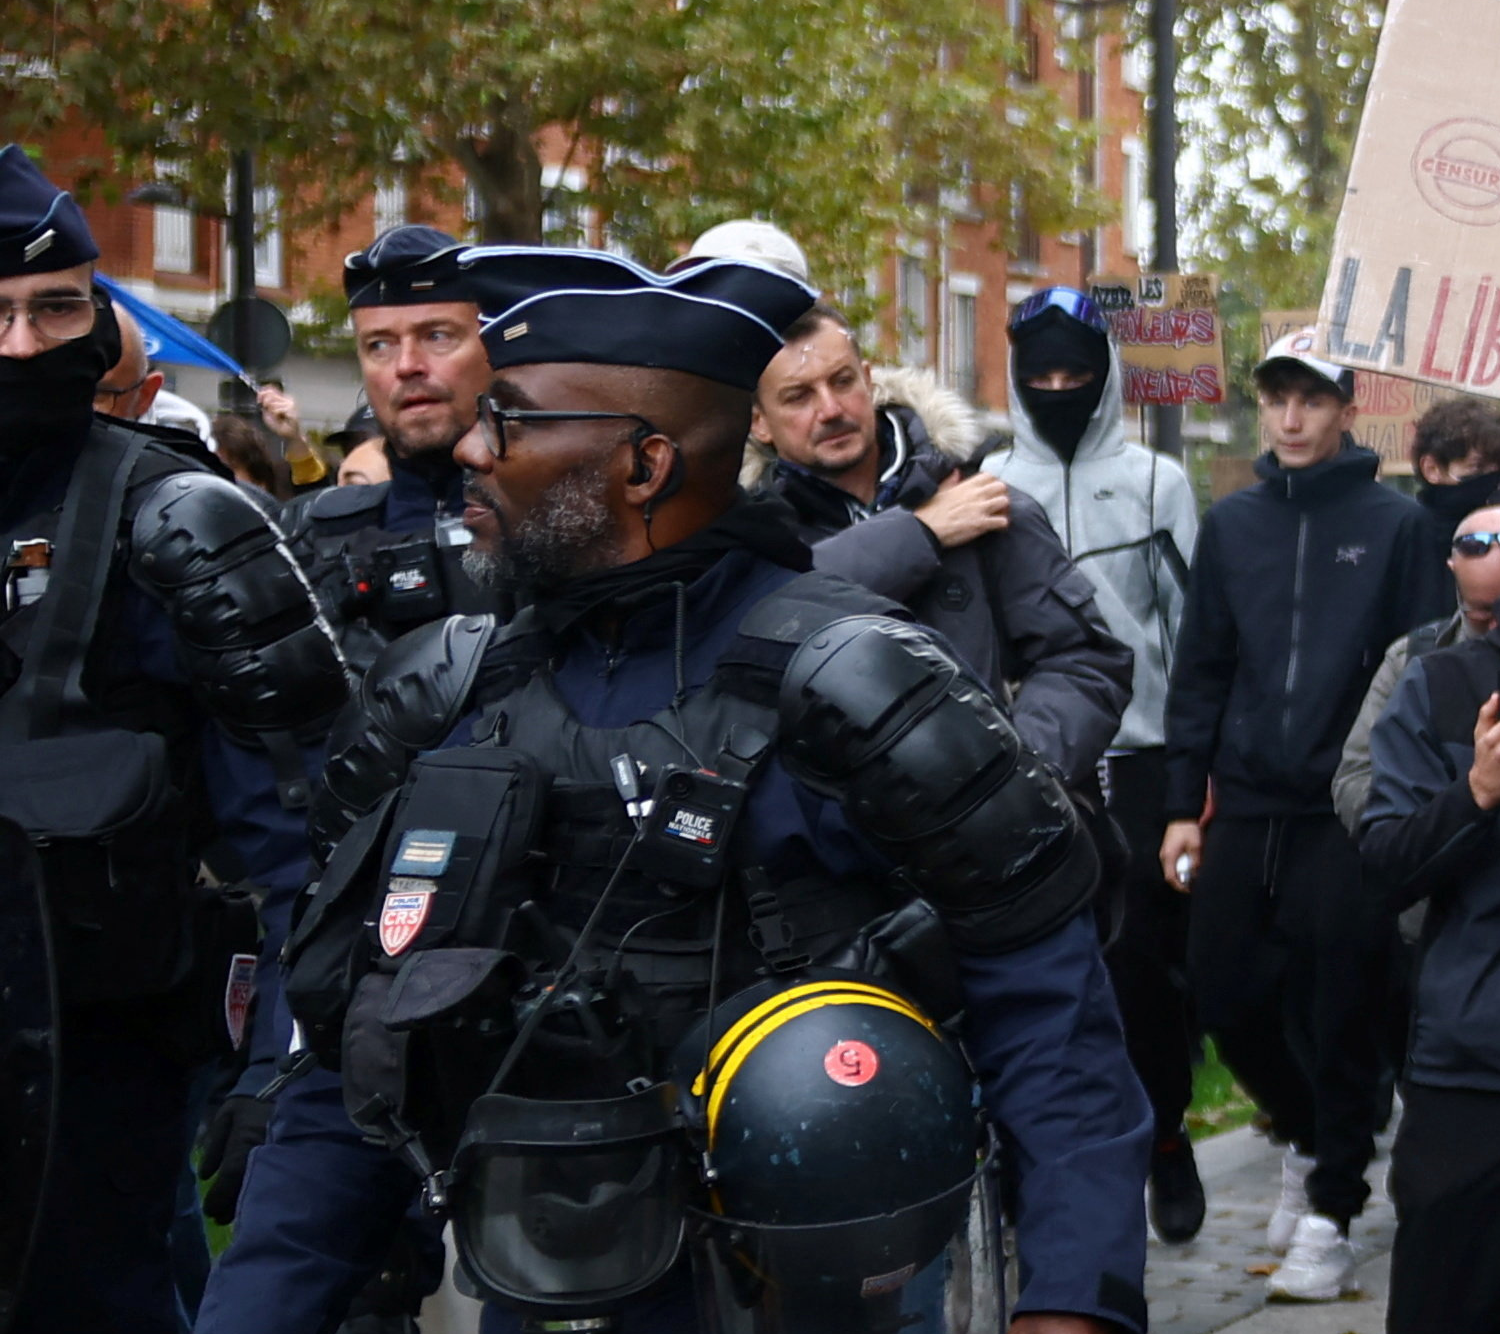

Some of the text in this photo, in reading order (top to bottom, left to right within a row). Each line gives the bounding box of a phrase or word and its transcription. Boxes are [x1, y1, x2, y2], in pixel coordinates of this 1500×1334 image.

[1328, 256, 1412, 367] LA
[668, 821, 712, 840] NATIONALE
[675, 810, 714, 832] POLICE
[384, 910, 420, 926] CRS
